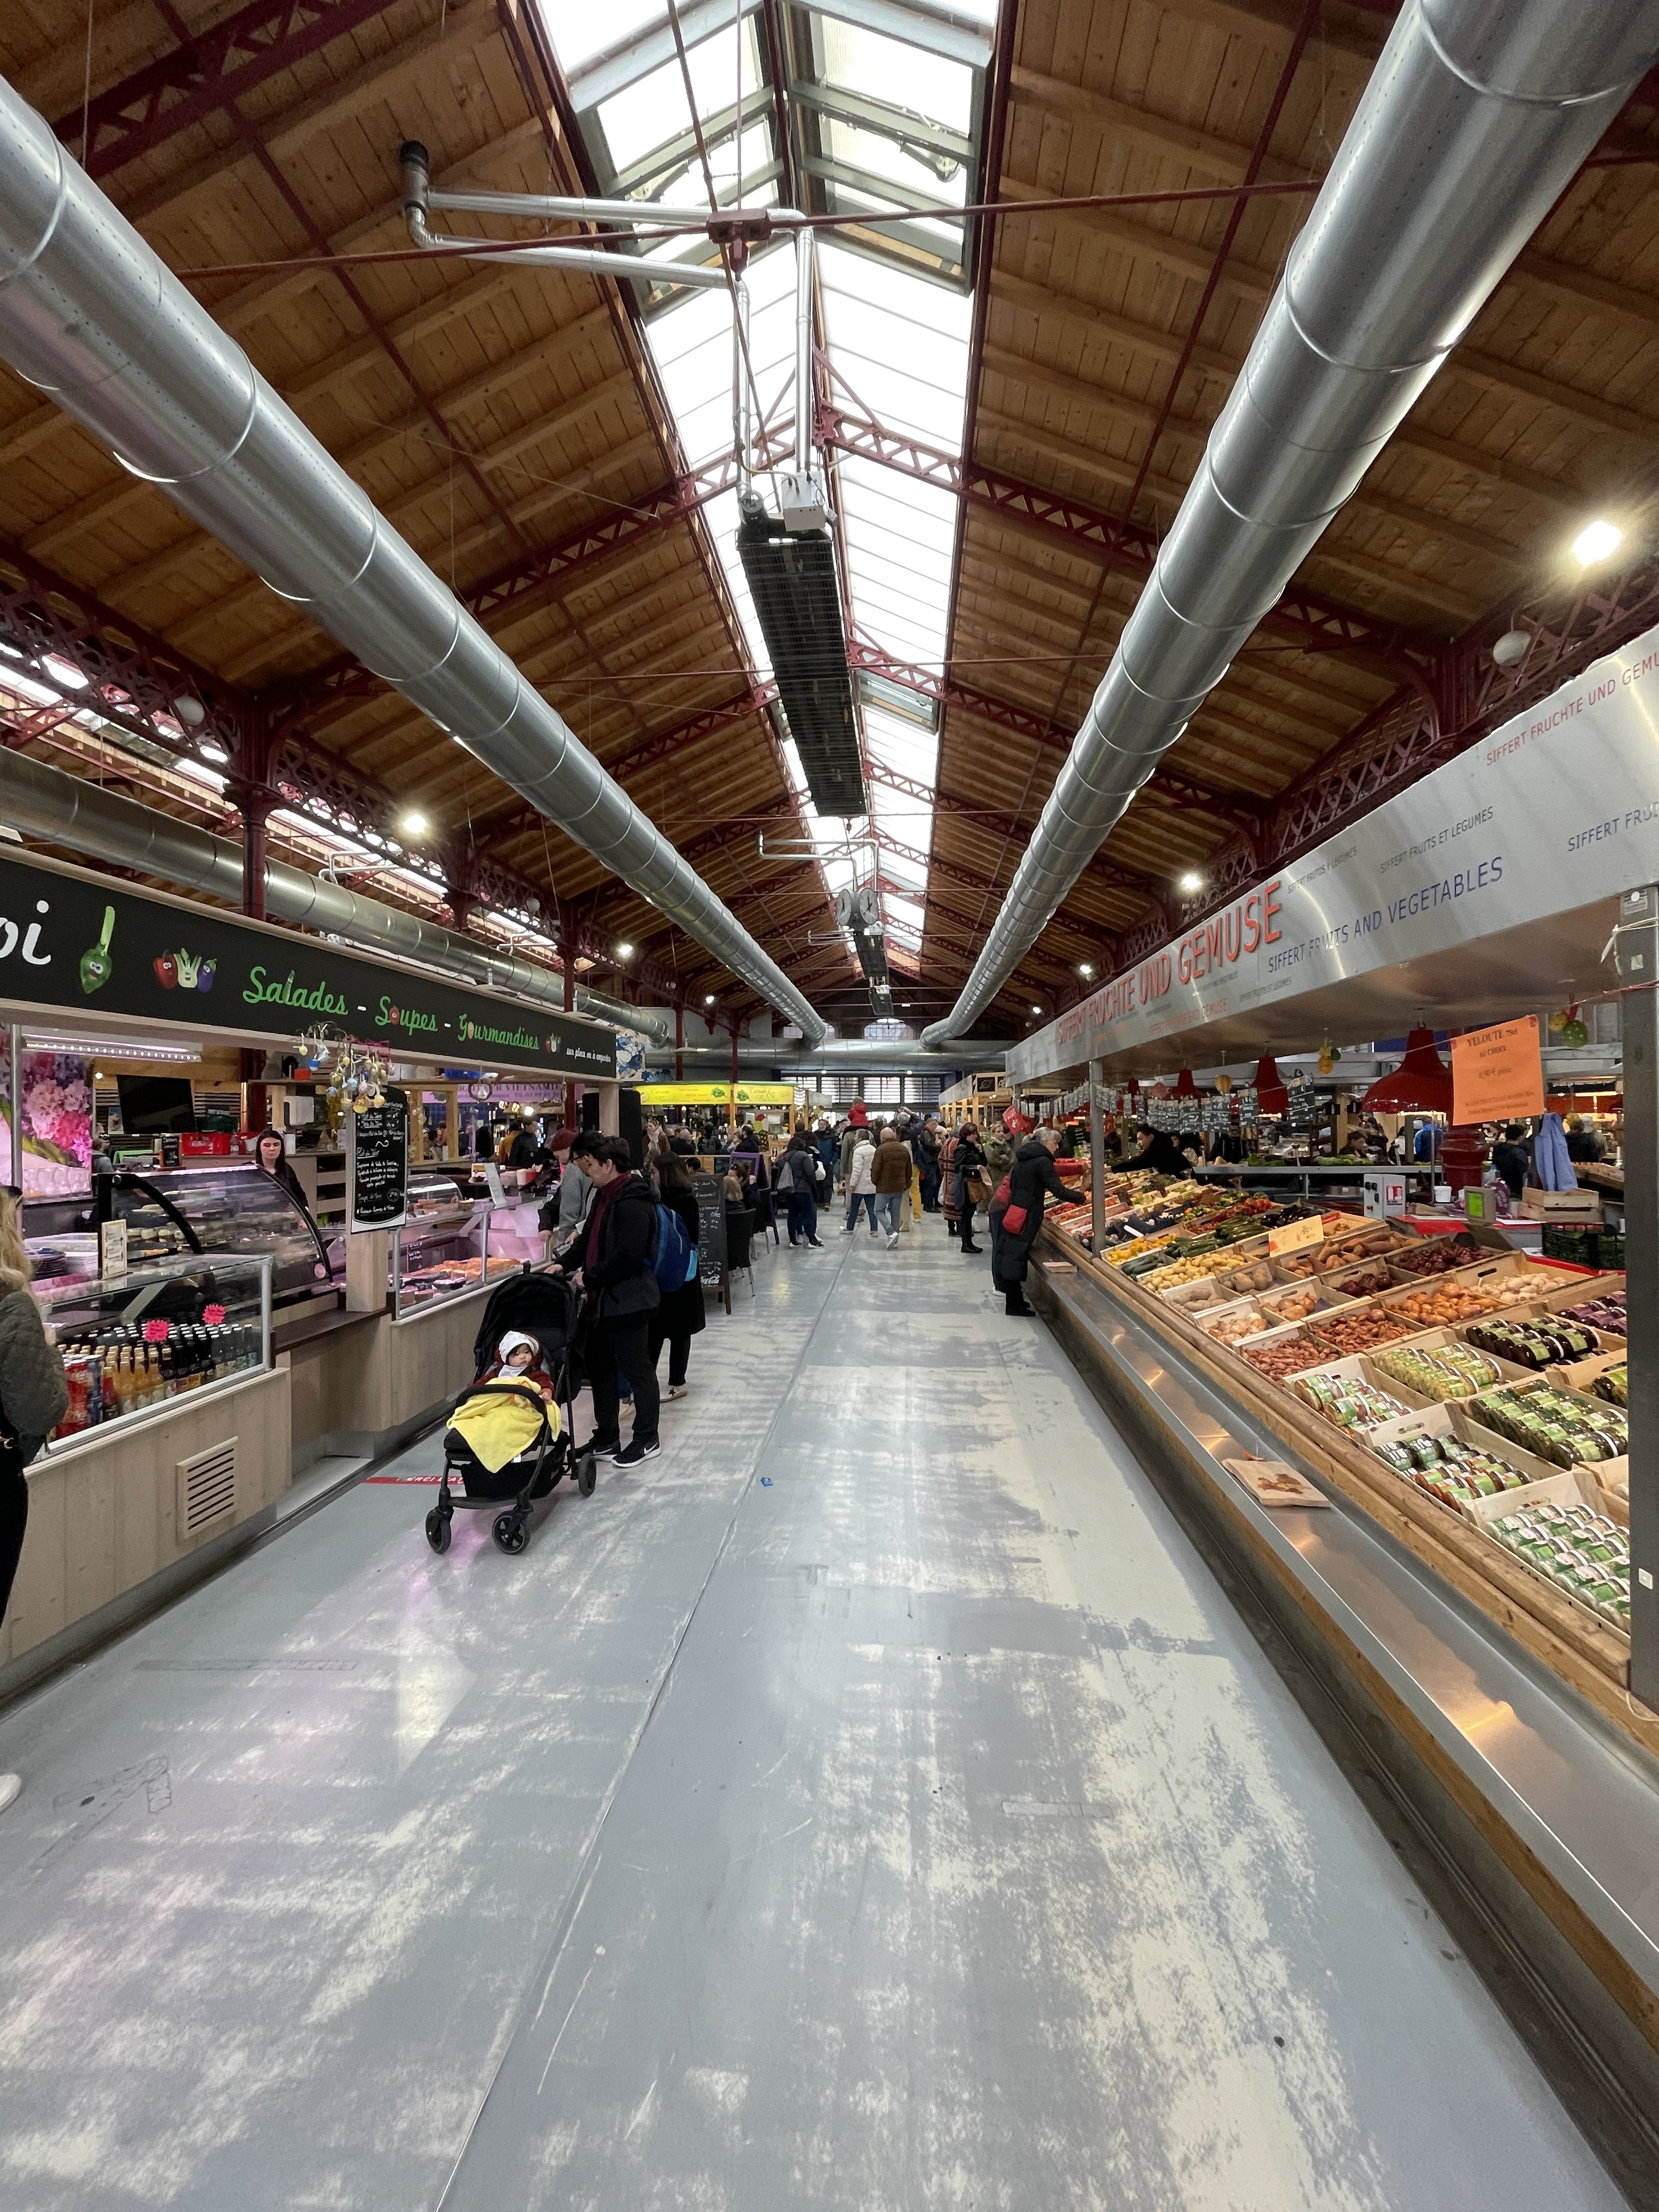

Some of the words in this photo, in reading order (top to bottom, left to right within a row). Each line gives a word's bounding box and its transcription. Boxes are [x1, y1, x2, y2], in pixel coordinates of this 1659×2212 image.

[1487, 731, 1527, 765] SIFFERT
[1530, 697, 1583, 740] FRUCHTE
[1588, 679, 1616, 706] UND
[1380, 851, 1408, 874] SIFFERT
[1409, 836, 1436, 859] FRUITS
[1438, 829, 1449, 844] ET
[1451, 806, 1493, 838] LEGUMES
[1567, 818, 1620, 851] SIFFERT
[1138, 953, 1172, 1005] UND
[1177, 879, 1282, 985] GEMUSE
[1269, 943, 1306, 973] SIFFERT
[1309, 924, 1348, 958] FRUITS
[1354, 910, 1383, 940] AND
[1387, 856, 1503, 924] VEGETABLES
[242, 966, 349, 1015] Salades
[375, 995, 438, 1036] Soupes
[458, 1013, 540, 1050] Gourmandises
[1466, 1029, 1504, 1047] VELOUTE
